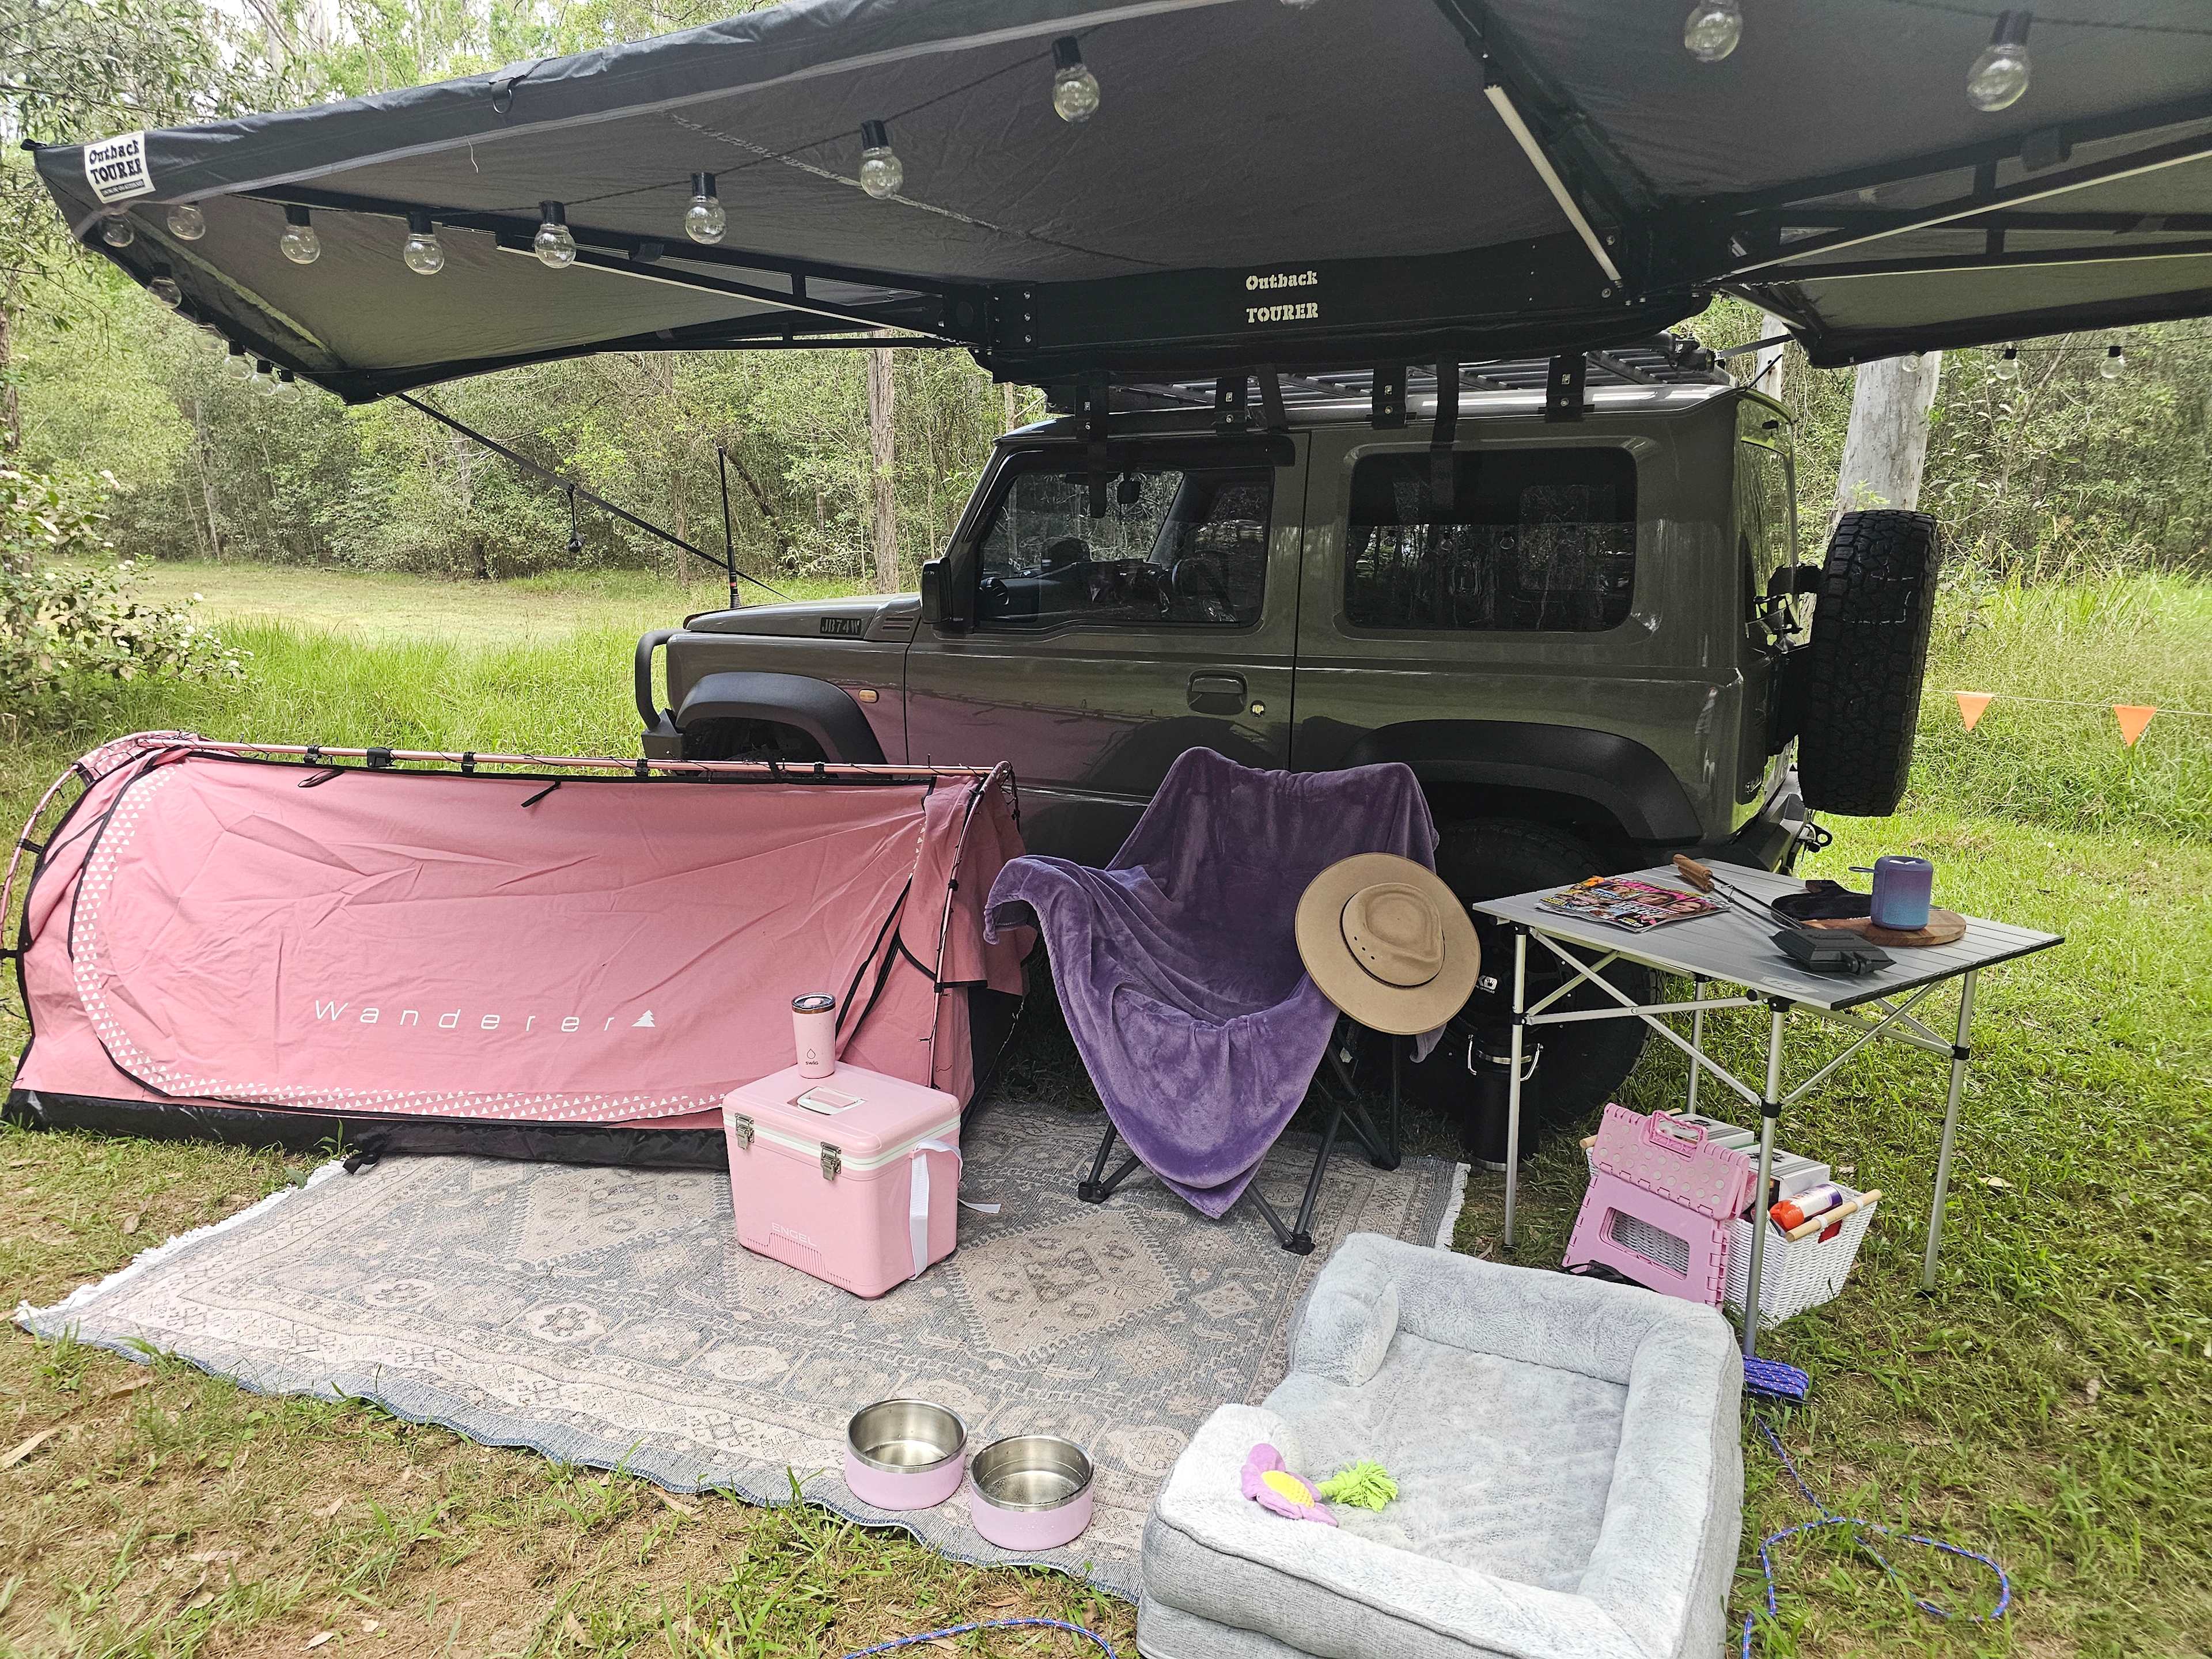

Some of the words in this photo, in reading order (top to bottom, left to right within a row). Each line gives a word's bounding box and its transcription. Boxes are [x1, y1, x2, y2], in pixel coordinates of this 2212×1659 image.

[89, 139, 139, 165] Outback
[90, 158, 143, 185] TOURER
[1245, 270, 1319, 290] Outback
[1245, 302, 1319, 324] TOURER
[821, 618, 861, 634] JB74W
[315, 999, 615, 1032] Wanderer
[771, 1222, 817, 1248] ENGEL
